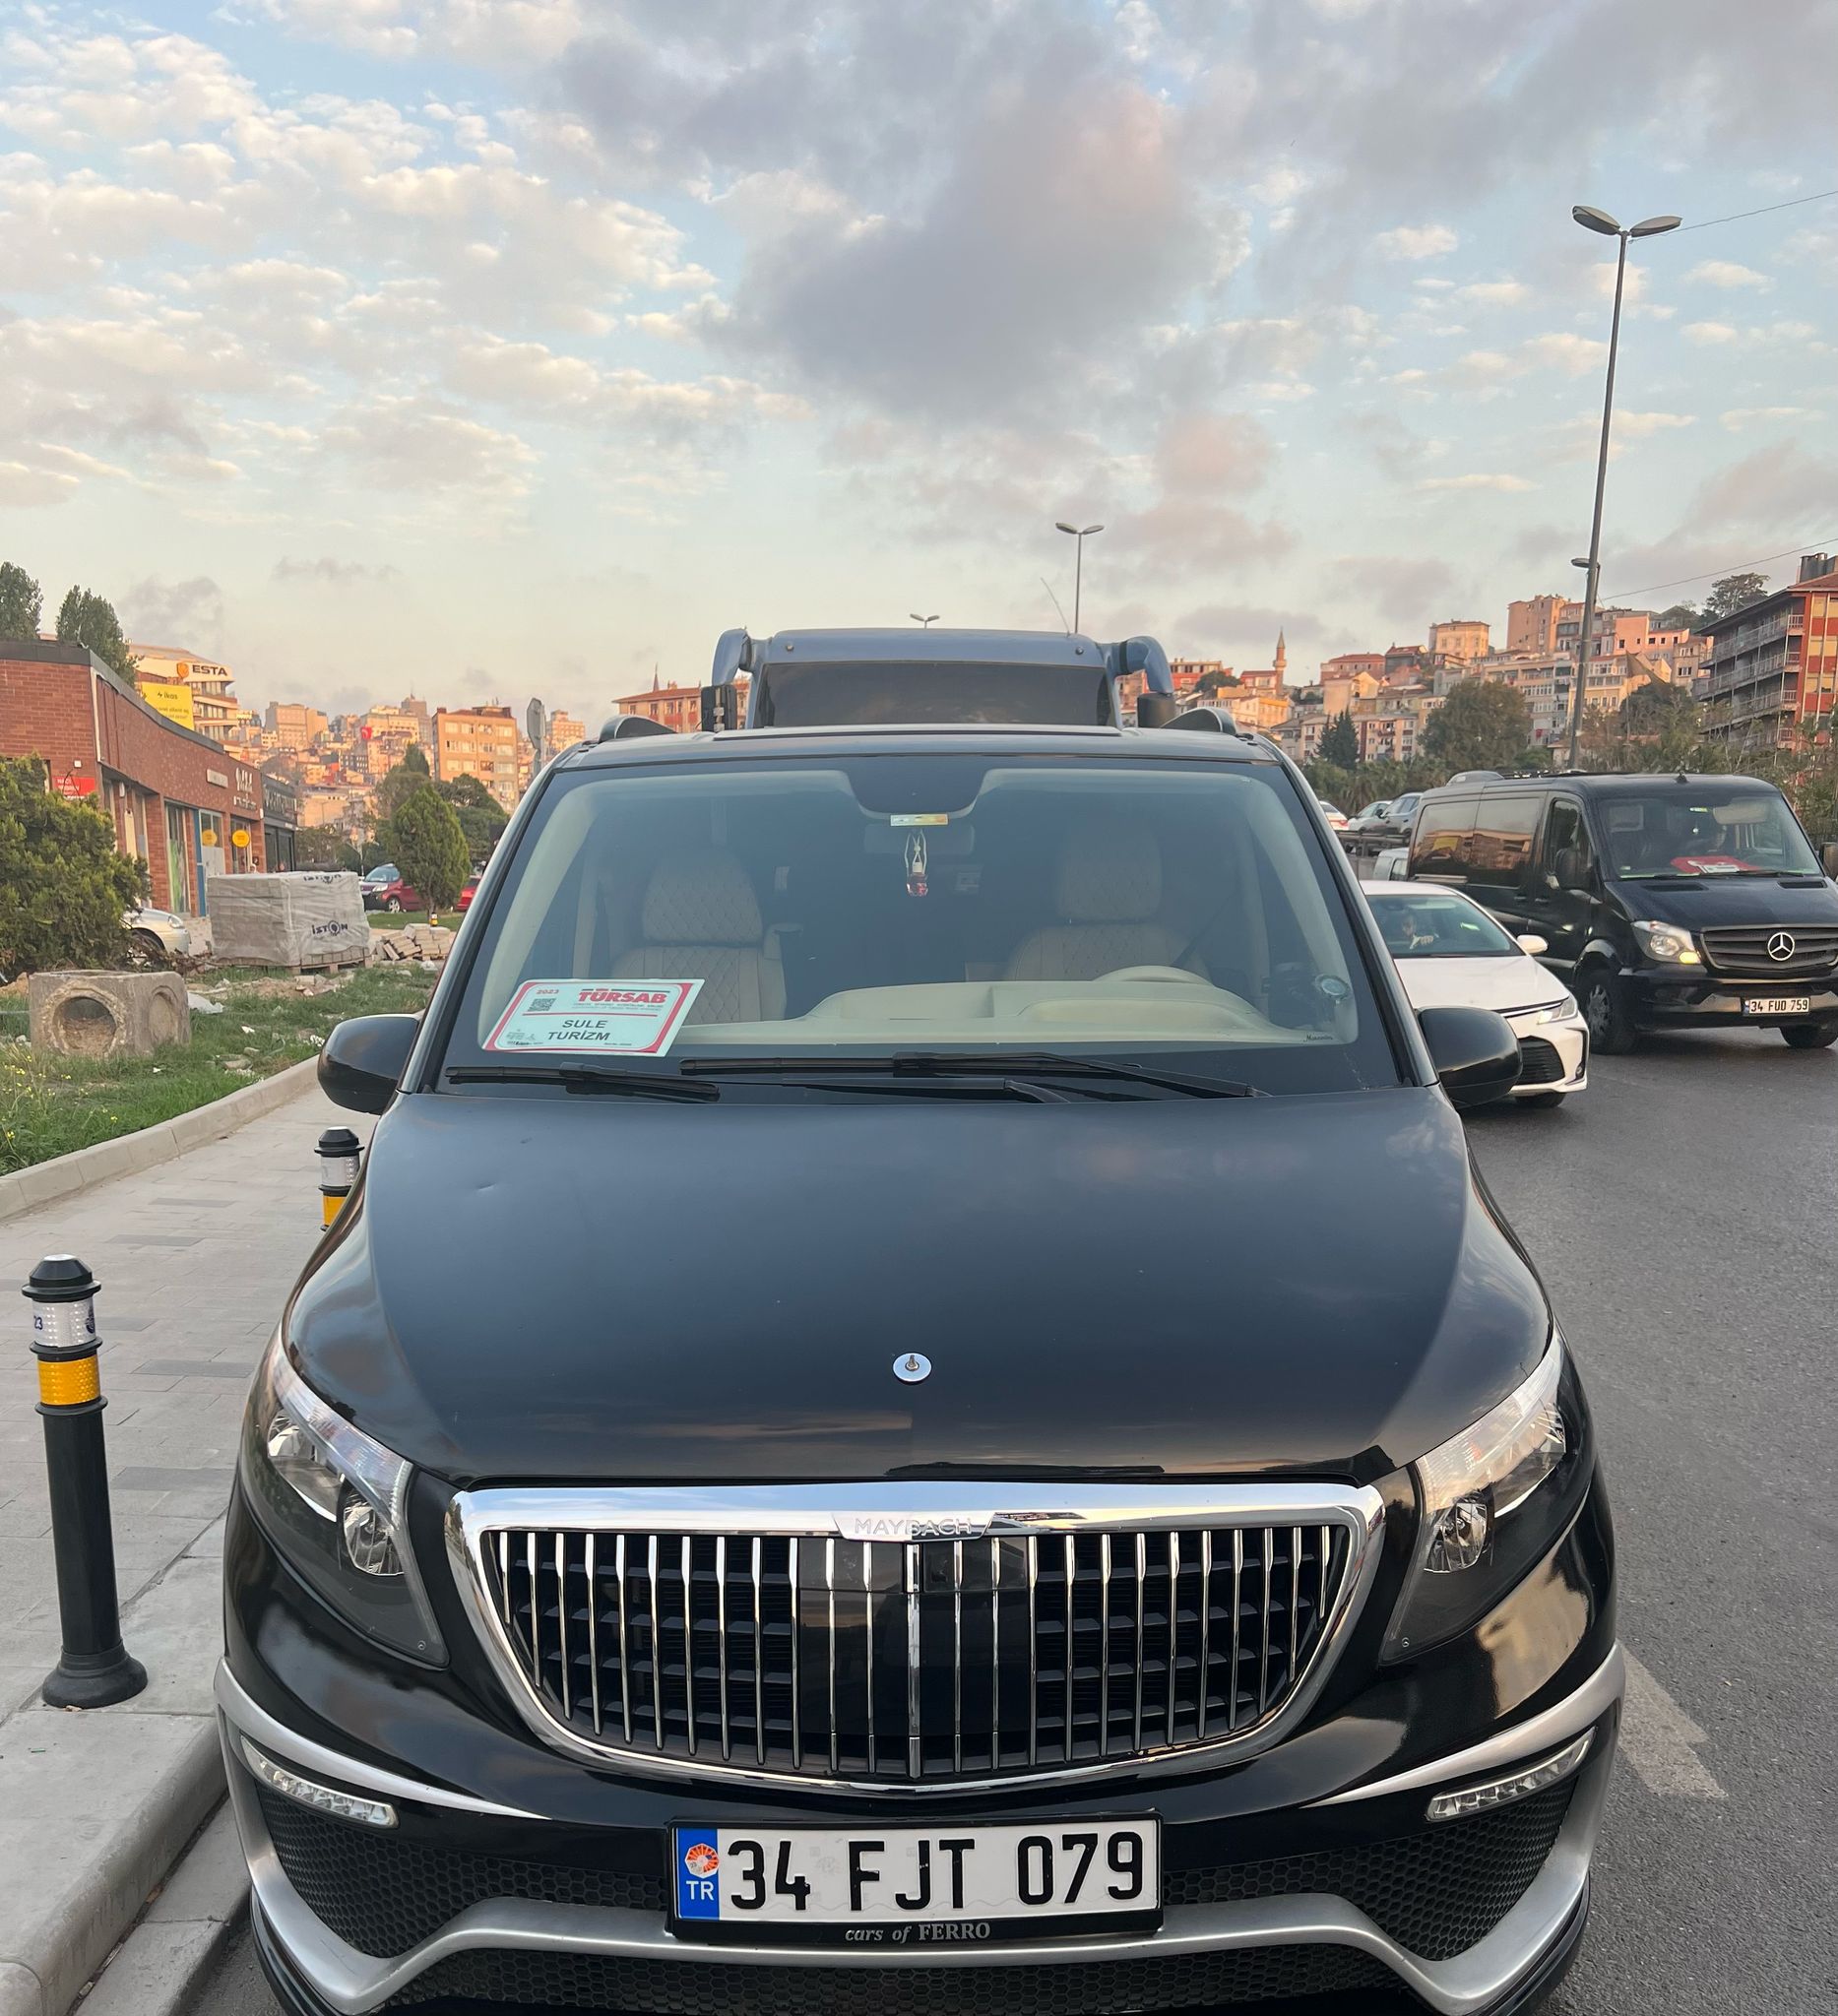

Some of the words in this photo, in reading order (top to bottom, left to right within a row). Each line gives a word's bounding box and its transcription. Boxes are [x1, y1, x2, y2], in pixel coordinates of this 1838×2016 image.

[192, 664, 227, 676] ESTA
[578, 988, 667, 1004] TÜRSAB
[1751, 1001, 1763, 1012] 34
[1791, 999, 1807, 1010] 759
[562, 1019, 608, 1029] SULE
[547, 1030, 610, 1041] TURİZM
[855, 1518, 972, 1537] MAYBACH
[728, 1839, 811, 1911] 34
[848, 1838, 976, 1912] FJT
[1016, 1831, 1144, 1906] 079
[685, 1880, 715, 1901] TR
[845, 1928, 884, 1941] cars
[892, 1925, 913, 1944] of
[919, 1922, 991, 1941] FERRO
